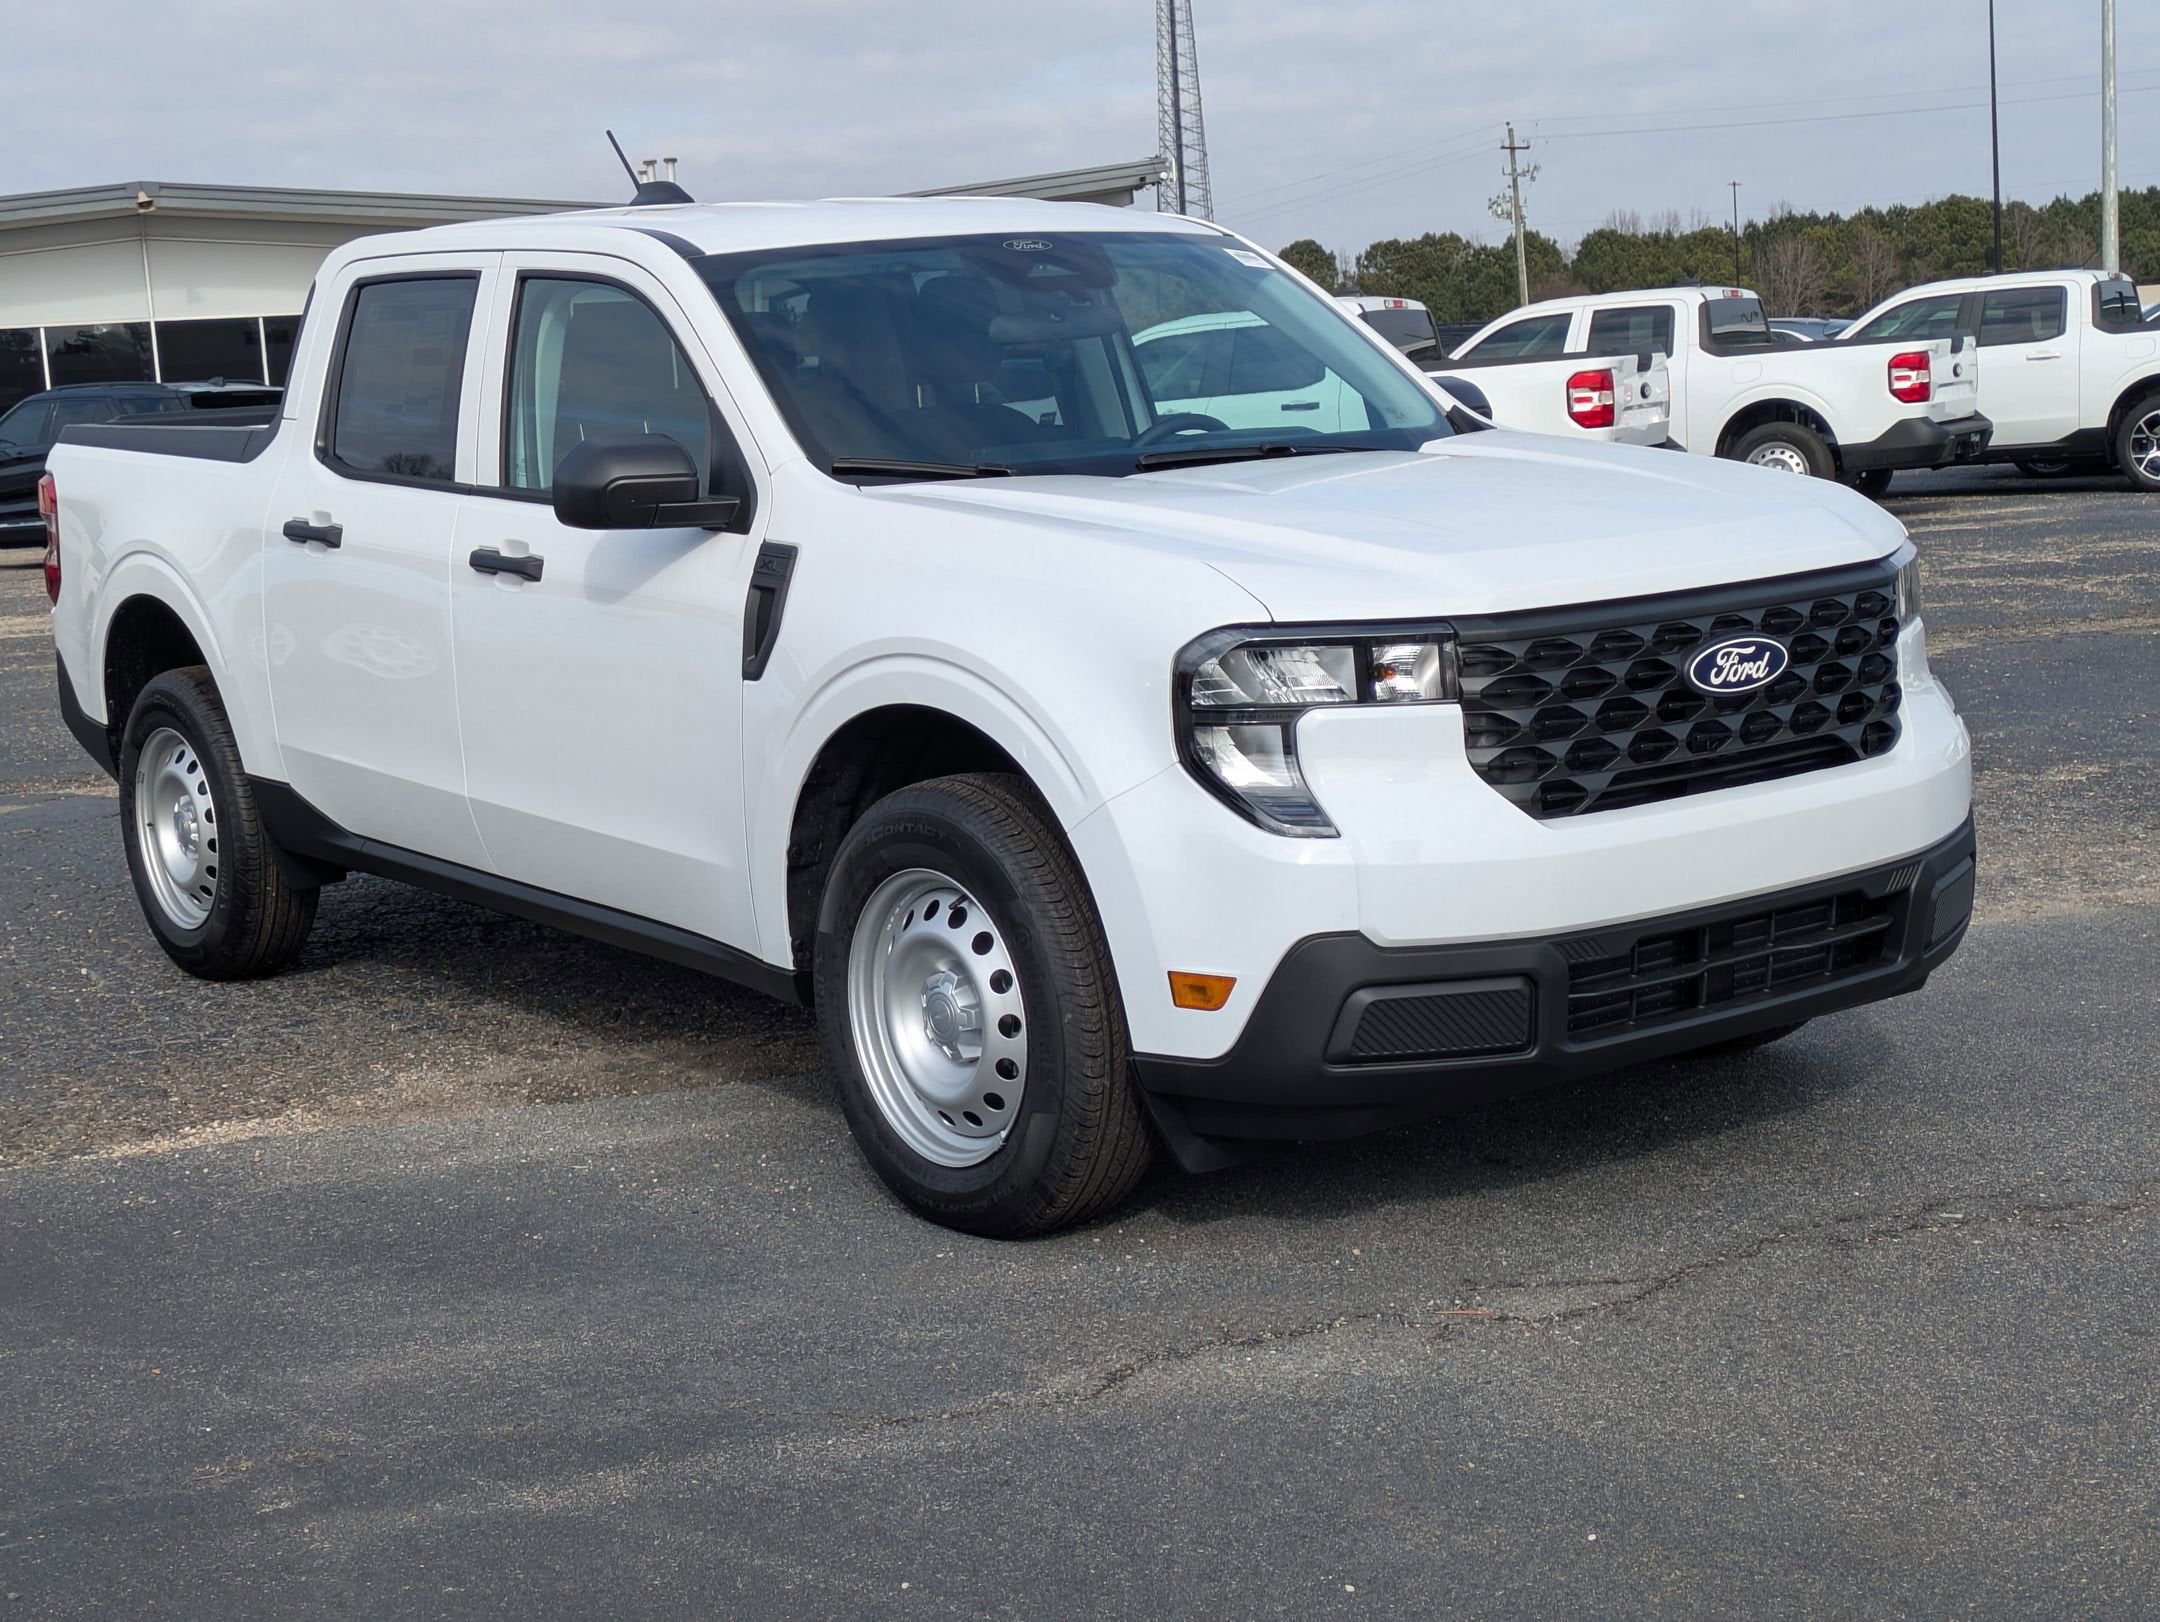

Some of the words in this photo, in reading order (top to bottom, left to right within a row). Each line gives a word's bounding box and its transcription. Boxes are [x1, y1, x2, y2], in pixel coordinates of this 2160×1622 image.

[1013, 240, 1043, 249] Ford
[759, 559, 782, 573] XL
[1710, 645, 1770, 685] Ford
